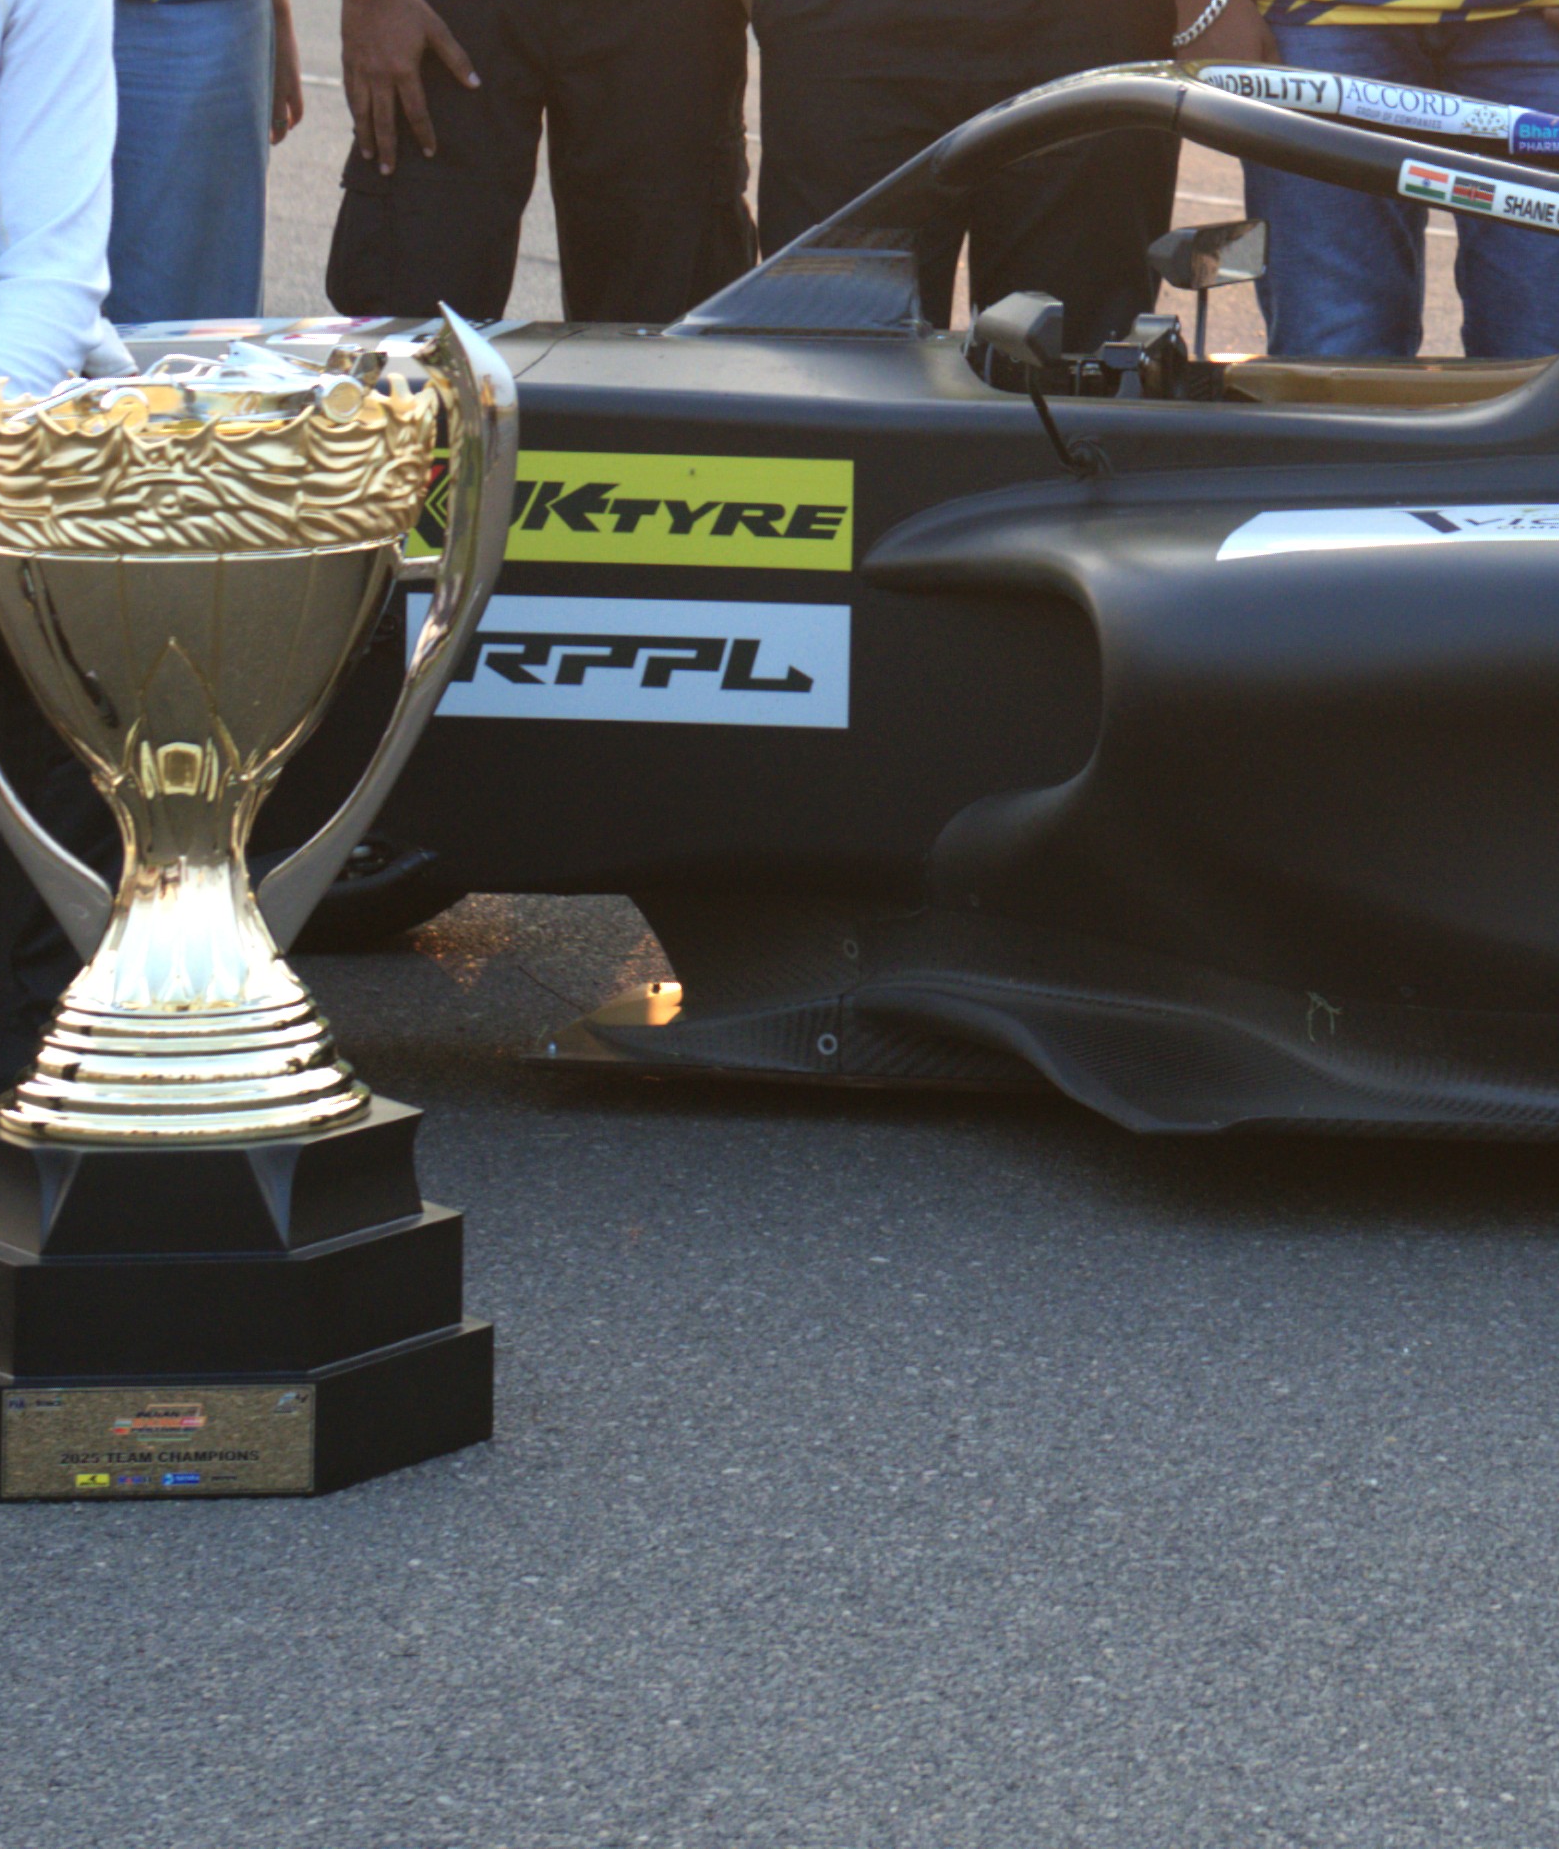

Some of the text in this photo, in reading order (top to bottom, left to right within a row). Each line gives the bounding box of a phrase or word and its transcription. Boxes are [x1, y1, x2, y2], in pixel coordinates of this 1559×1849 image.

[1346, 78, 1463, 117] ACCORD
[1355, 106, 1442, 129] GROUP OF COMPANIES
[1502, 194, 1555, 224] SHANE
[452, 630, 814, 693] RPPL
[61, 1450, 260, 1464] 2025 TEAM CHAMPIONS
